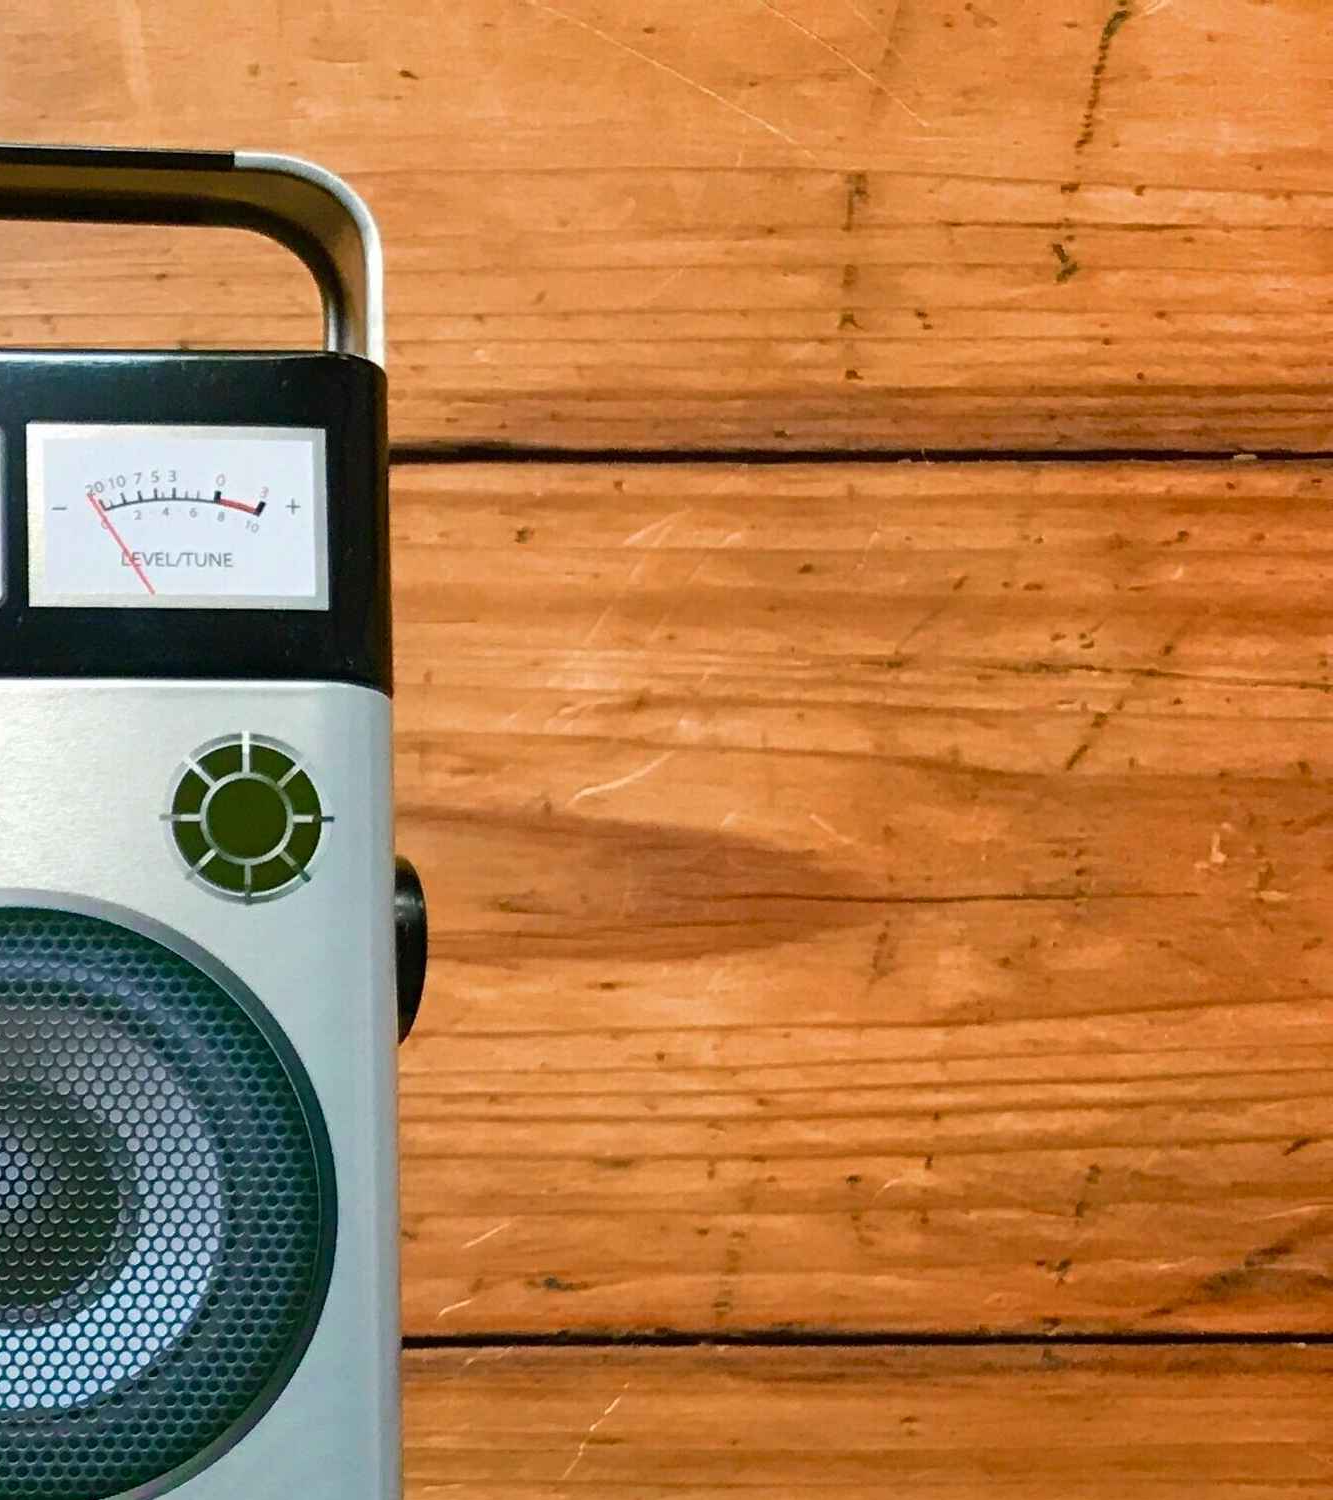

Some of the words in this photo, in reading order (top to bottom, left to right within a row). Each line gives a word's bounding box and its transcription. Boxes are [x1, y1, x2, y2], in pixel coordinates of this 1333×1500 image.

[109, 475, 126, 489] 10
[133, 472, 142, 486] 7
[151, 470, 160, 483] 5
[168, 470, 177, 483] 3
[215, 474, 226, 487] 0
[121, 551, 234, 568] LEVEL/TUNE
